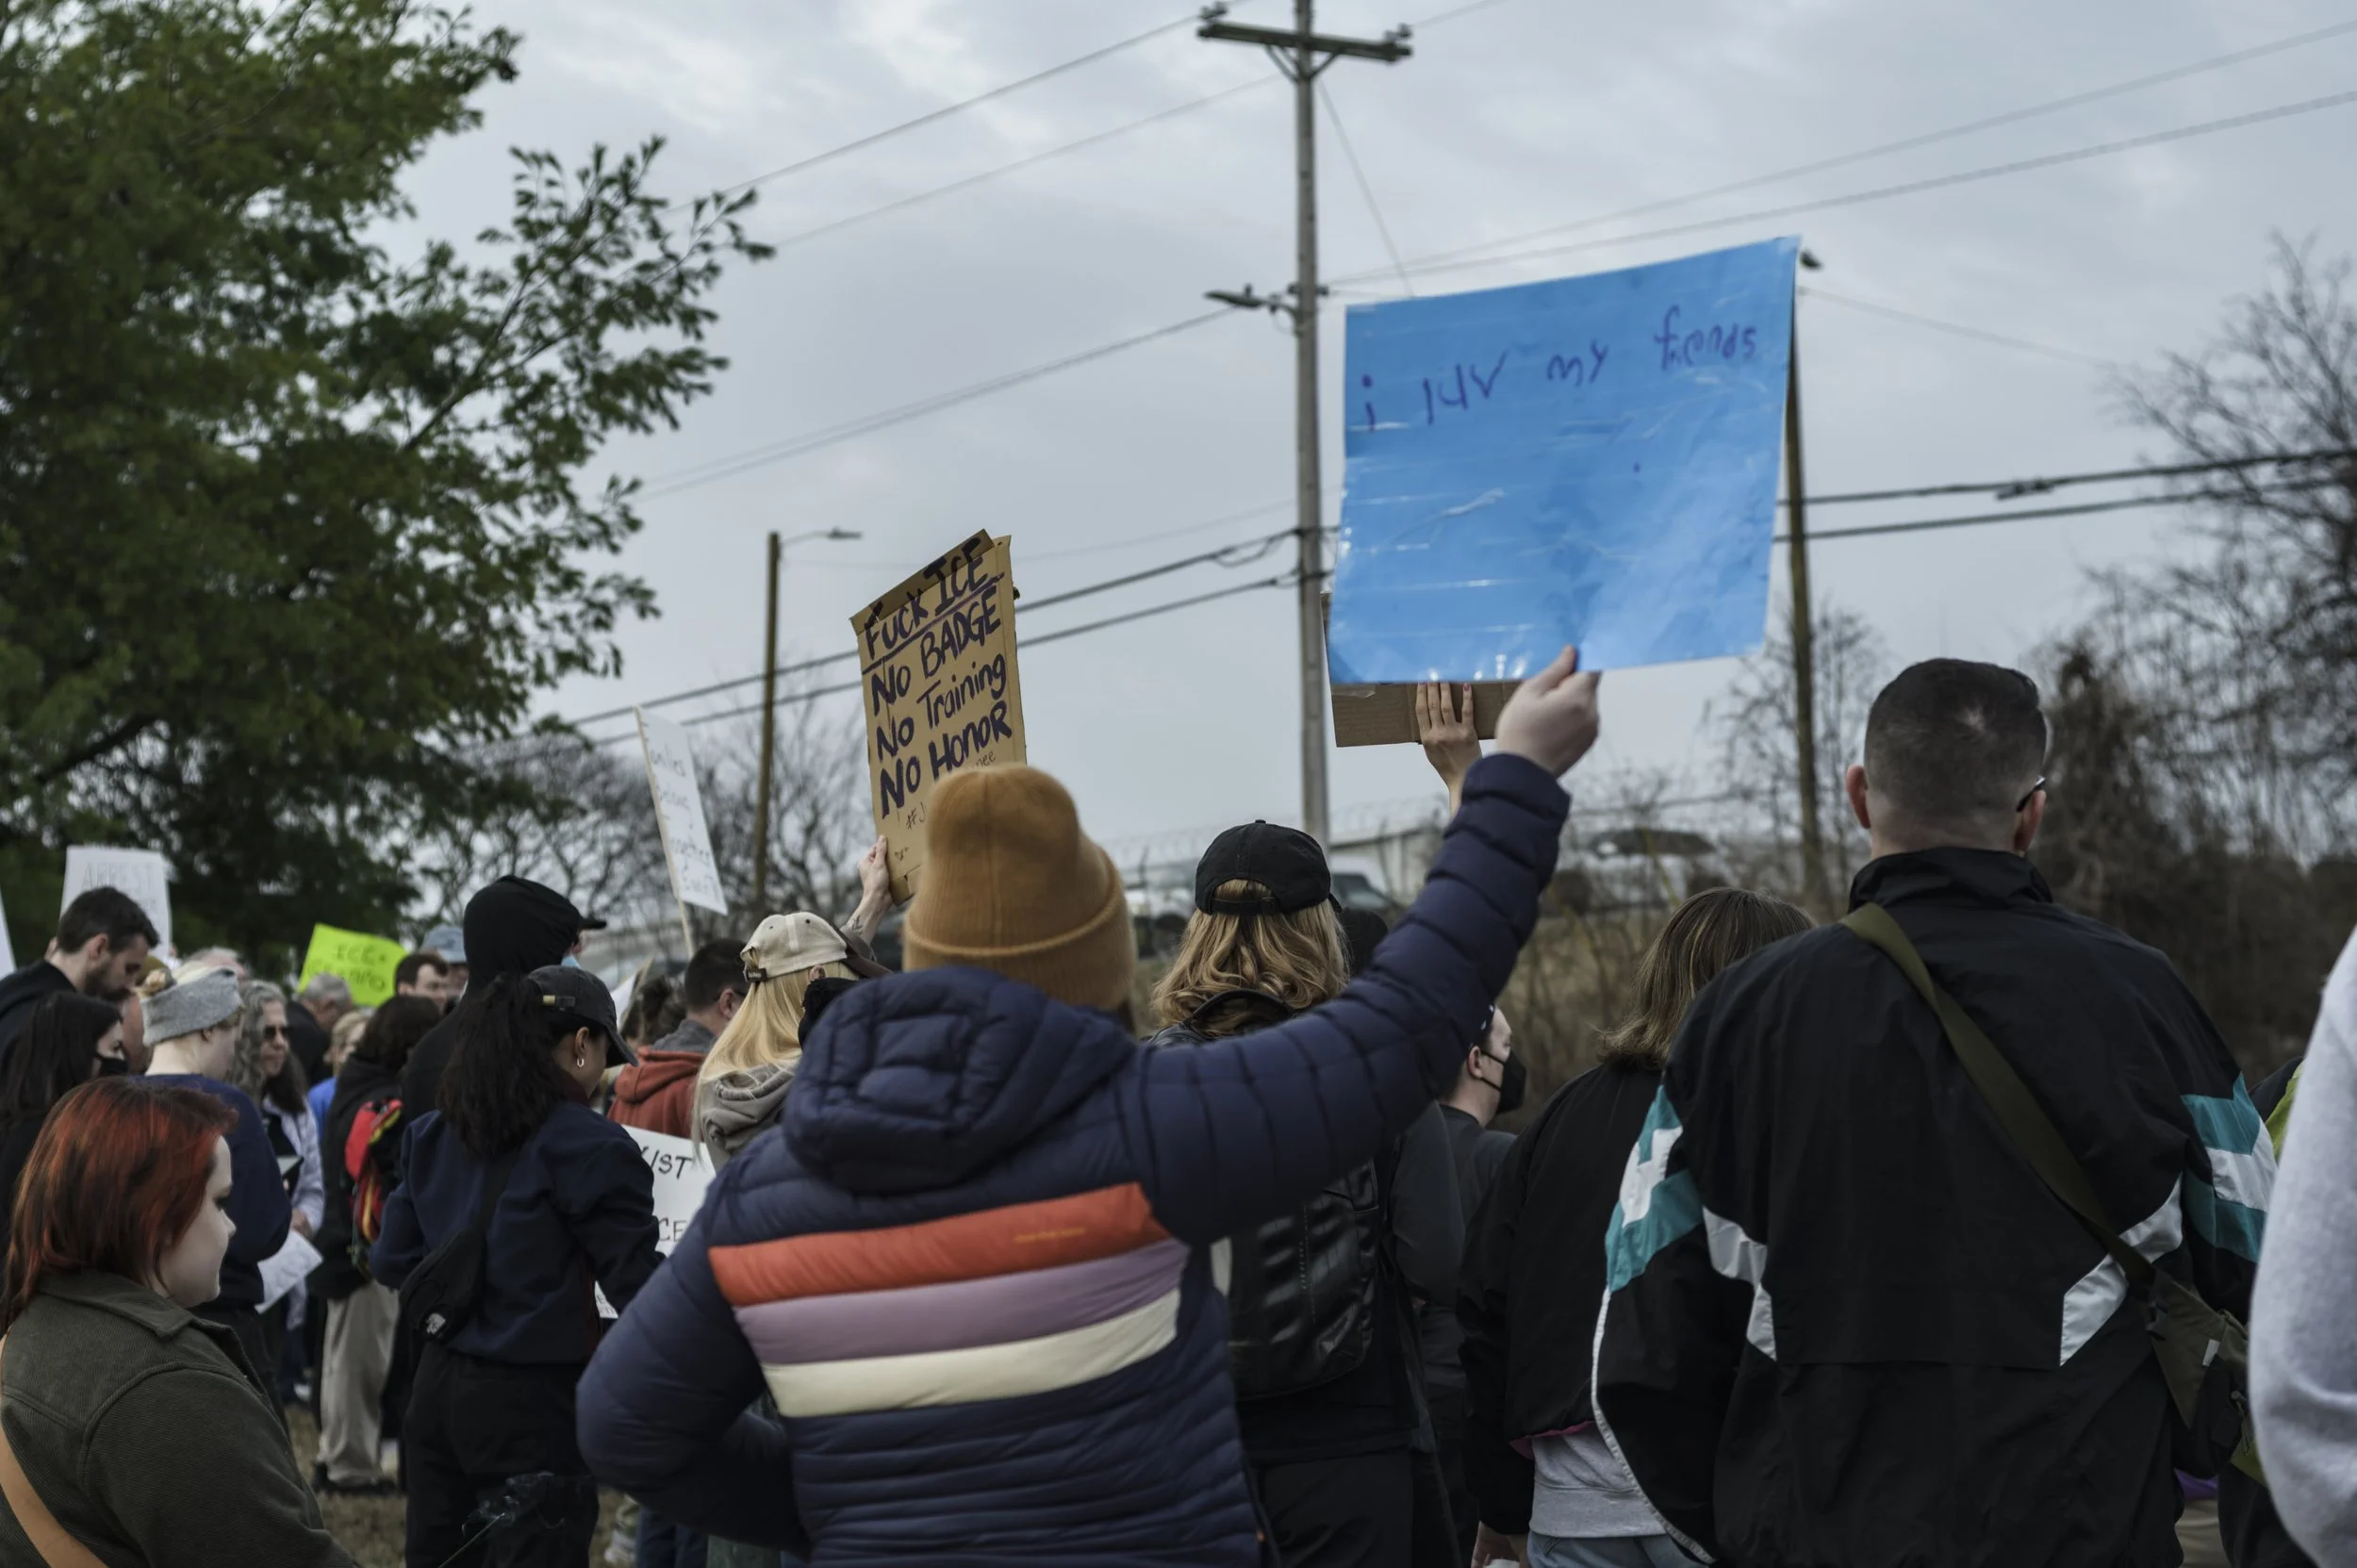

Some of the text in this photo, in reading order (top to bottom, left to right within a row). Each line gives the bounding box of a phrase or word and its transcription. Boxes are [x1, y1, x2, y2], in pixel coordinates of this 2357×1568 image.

[1361, 373, 1376, 434] i
[1546, 338, 1610, 388] my
[864, 536, 989, 661] FUCK ICE
[919, 585, 1001, 680] BADGE
[915, 652, 1007, 730] Training
